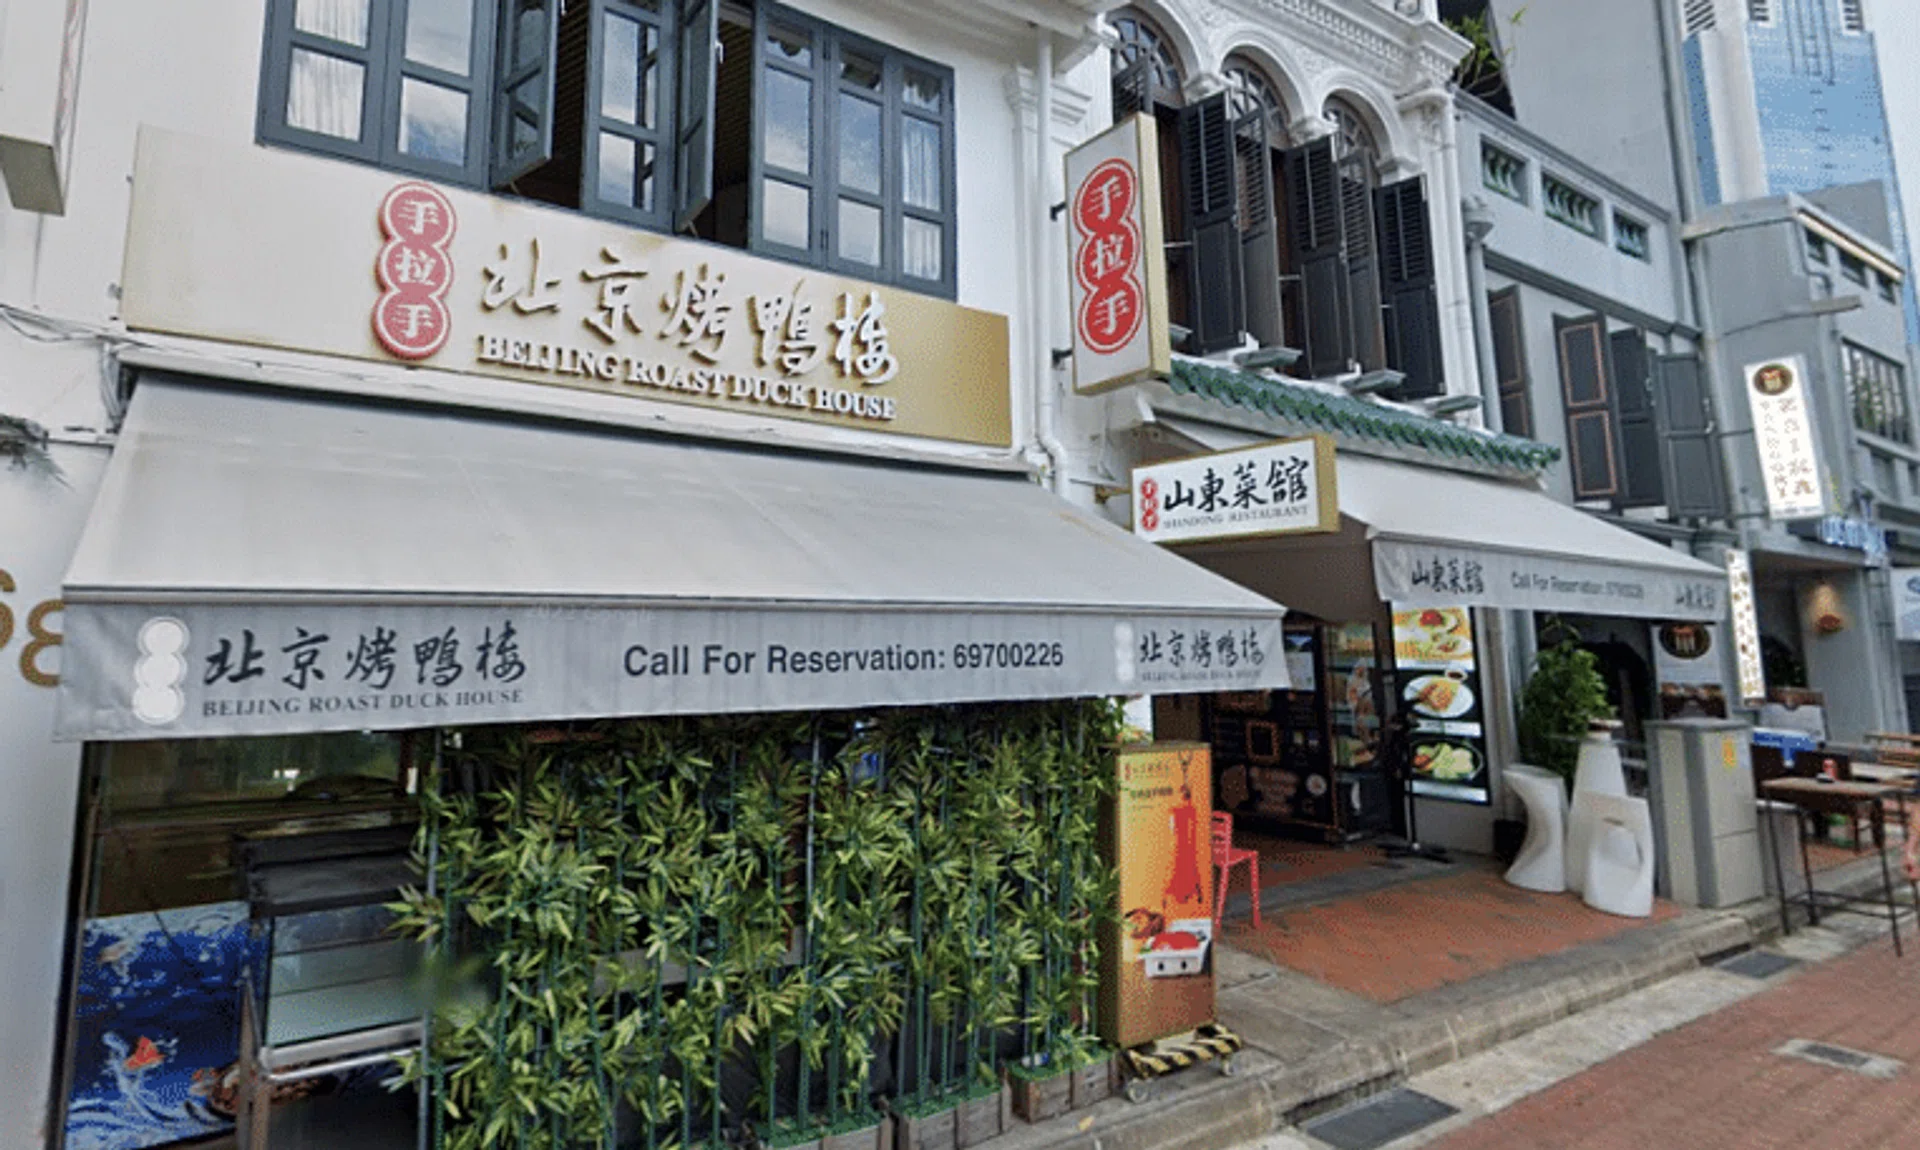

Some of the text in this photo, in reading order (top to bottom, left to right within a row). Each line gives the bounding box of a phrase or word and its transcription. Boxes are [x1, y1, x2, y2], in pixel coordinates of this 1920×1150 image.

[391, 194, 443, 343] 手拉手
[1082, 170, 1135, 341] 手拉手
[477, 334, 898, 422] BEIJING ROAST DUCK HOUSE
[202, 688, 524, 717] BEIJING ROAST DUCK HOUSE
[623, 642, 1064, 677] Call For Reservation: 69700226
